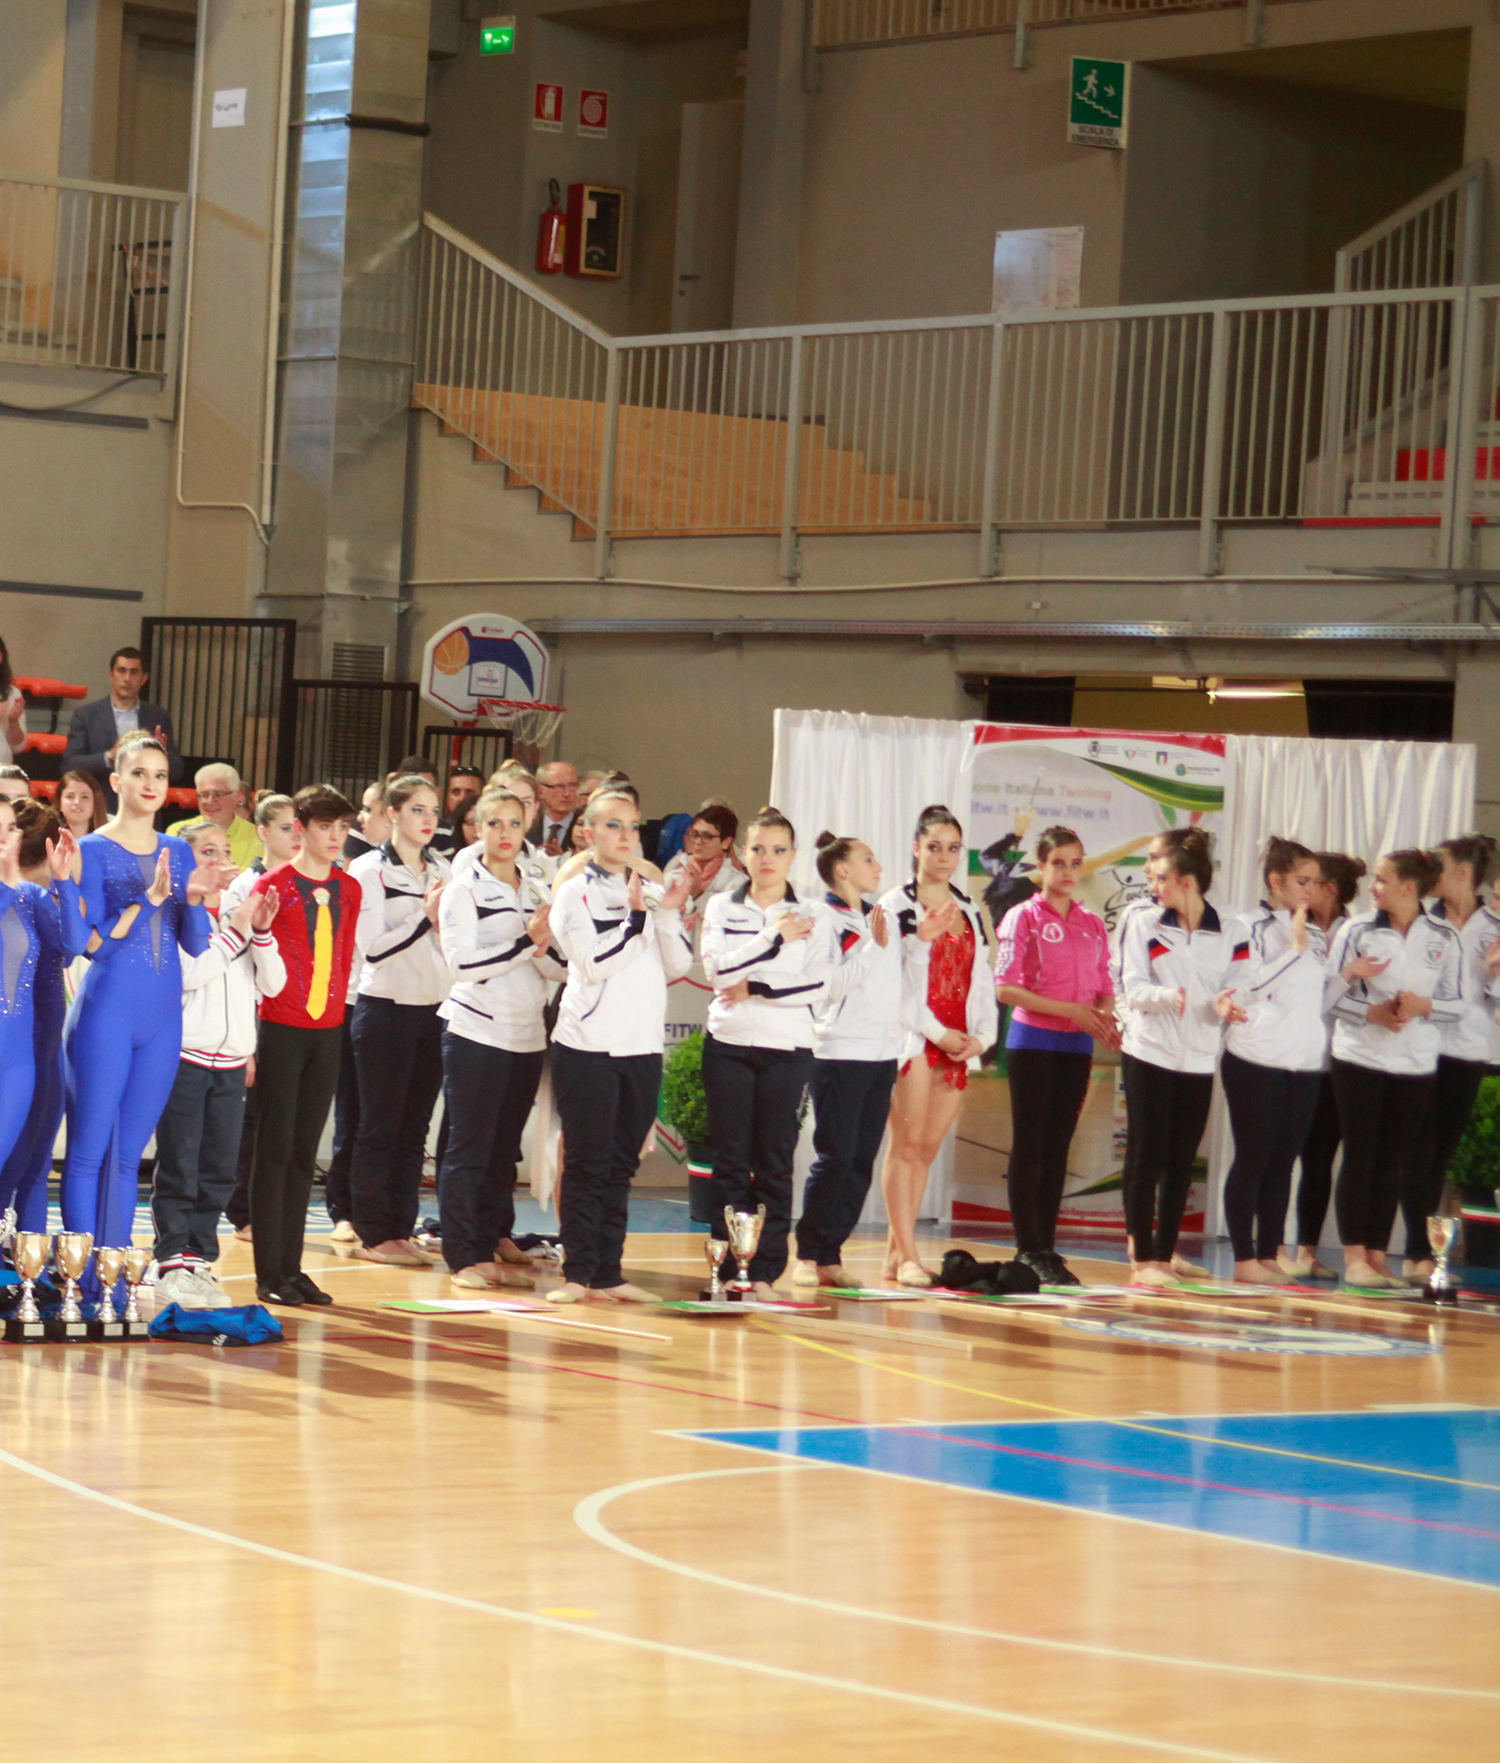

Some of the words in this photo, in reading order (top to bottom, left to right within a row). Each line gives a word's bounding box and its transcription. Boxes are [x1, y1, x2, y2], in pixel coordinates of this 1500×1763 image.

[1078, 124, 1104, 135] SCALA
[1105, 127, 1114, 137] DI
[1071, 133, 1120, 147] EMERGENZA
